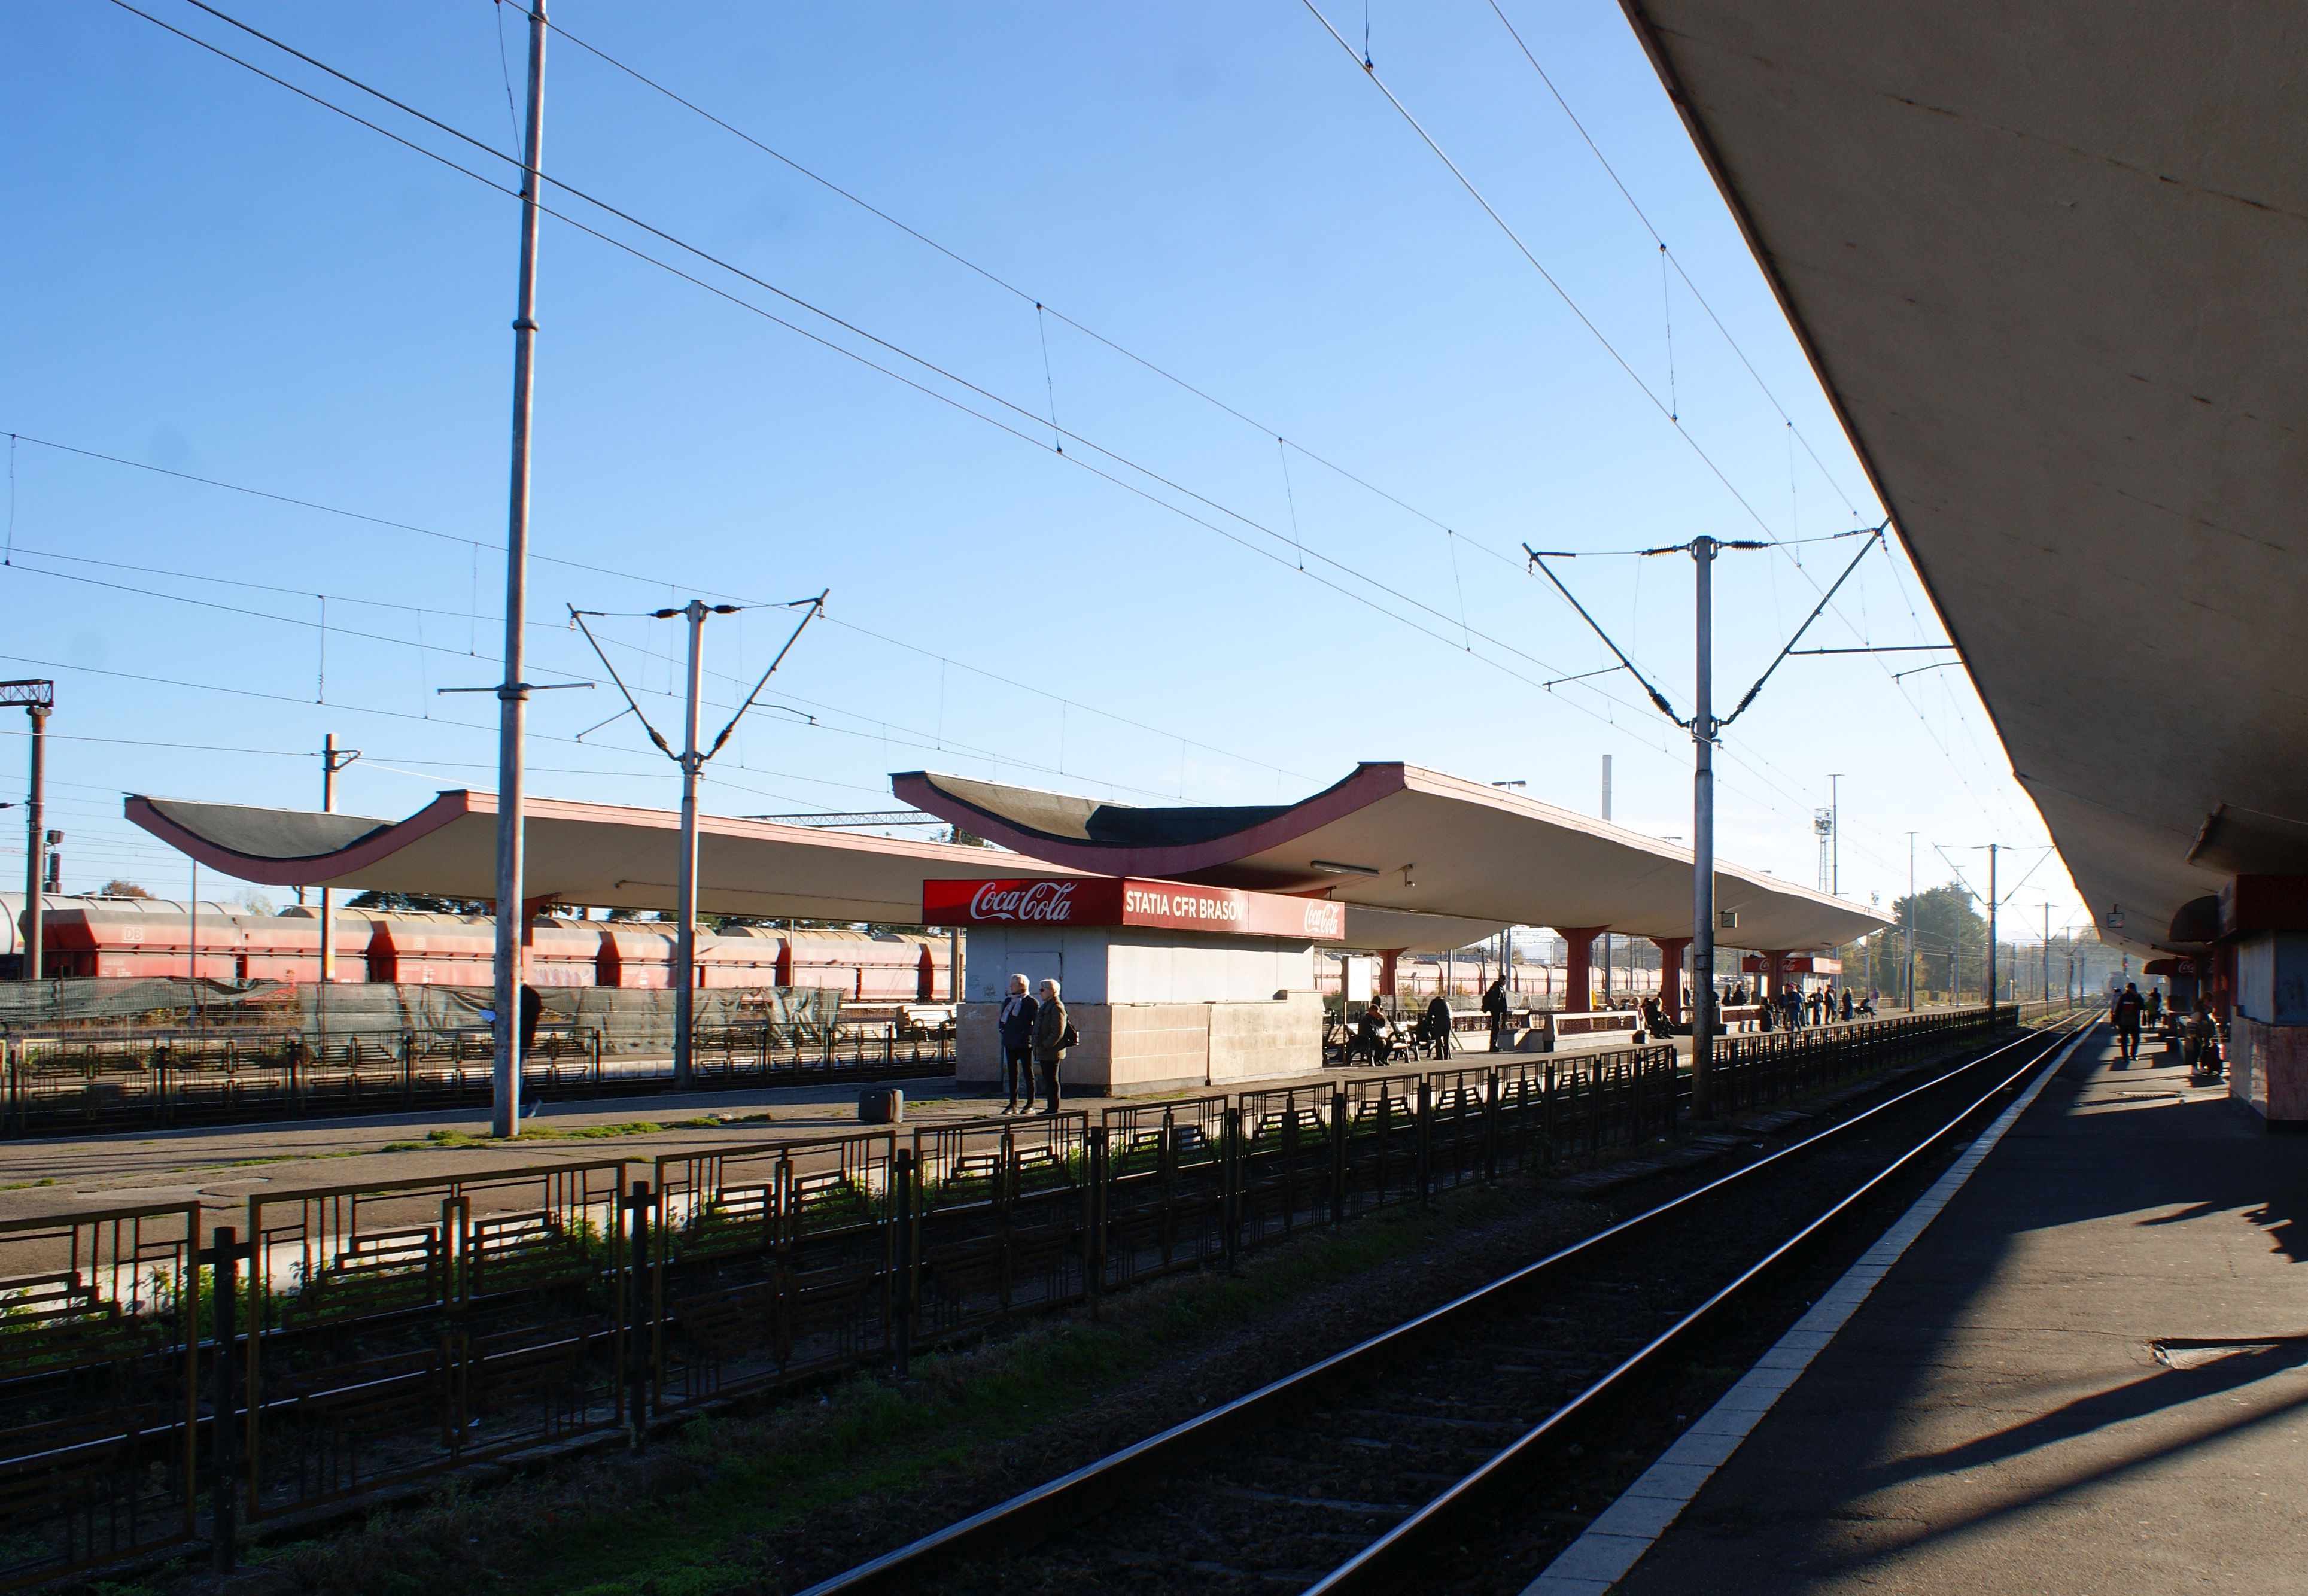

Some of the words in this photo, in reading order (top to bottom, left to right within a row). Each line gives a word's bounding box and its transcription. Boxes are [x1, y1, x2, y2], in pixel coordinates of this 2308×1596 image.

[970, 882, 1078, 920] Coca-Cola
[1126, 890, 1170, 916] STATIA
[1173, 896, 1197, 918] CFR
[1200, 898, 1245, 921] BRASOV
[125, 928, 142, 940] DB
[1304, 901, 1340, 935] Coca-Cola
